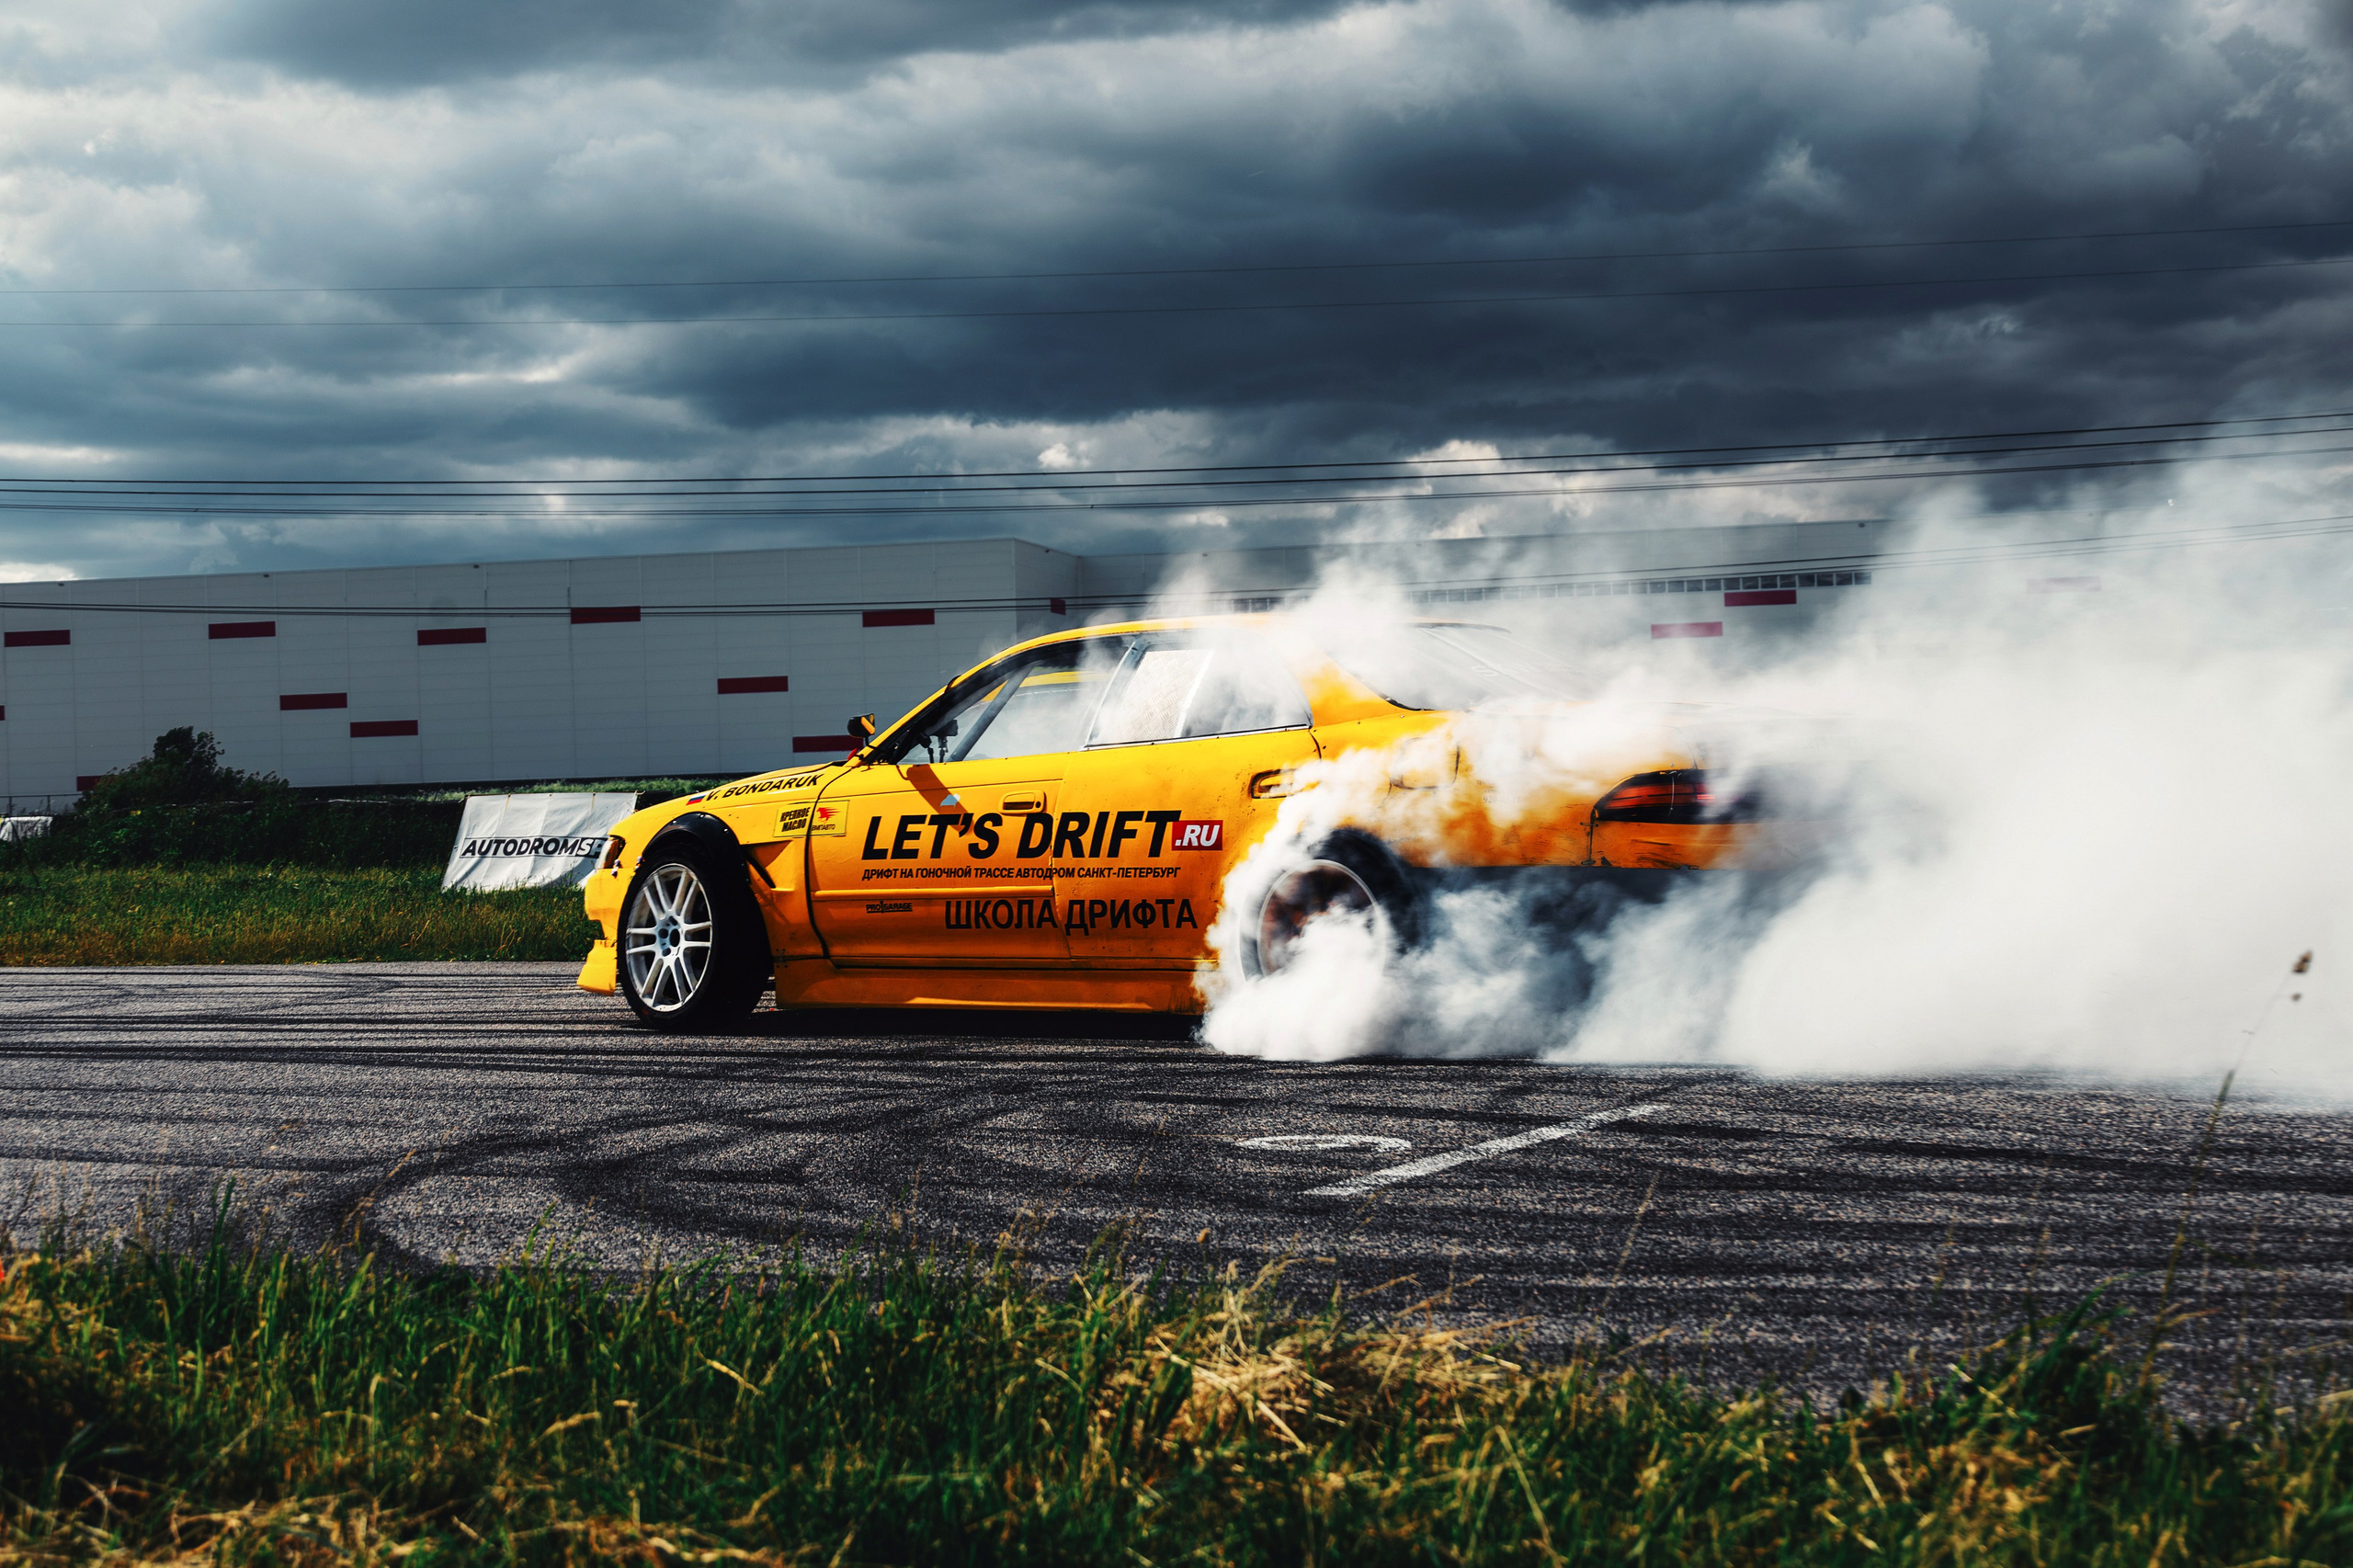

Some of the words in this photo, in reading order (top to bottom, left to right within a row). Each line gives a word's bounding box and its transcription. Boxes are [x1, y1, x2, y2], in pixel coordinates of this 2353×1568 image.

[706, 790, 722, 801] V.
[722, 773, 824, 798] BONDARUK
[781, 818, 807, 832] МАСЛО
[1016, 810, 1182, 858] DRIFT
[1174, 824, 1219, 847] .RU
[861, 869, 899, 881] ДРИФТ
[900, 869, 915, 878] НА
[915, 866, 972, 879] ГОНОЧНОЙ
[973, 868, 1015, 879] ТРАССЕ
[1015, 868, 1075, 881] АВТОДРОМ
[1076, 867, 1181, 879] САНКТ-ПЕТЕРБУРГ
[945, 900, 1058, 929] ШКОЛА
[1064, 898, 1199, 937] ДРИФТА
